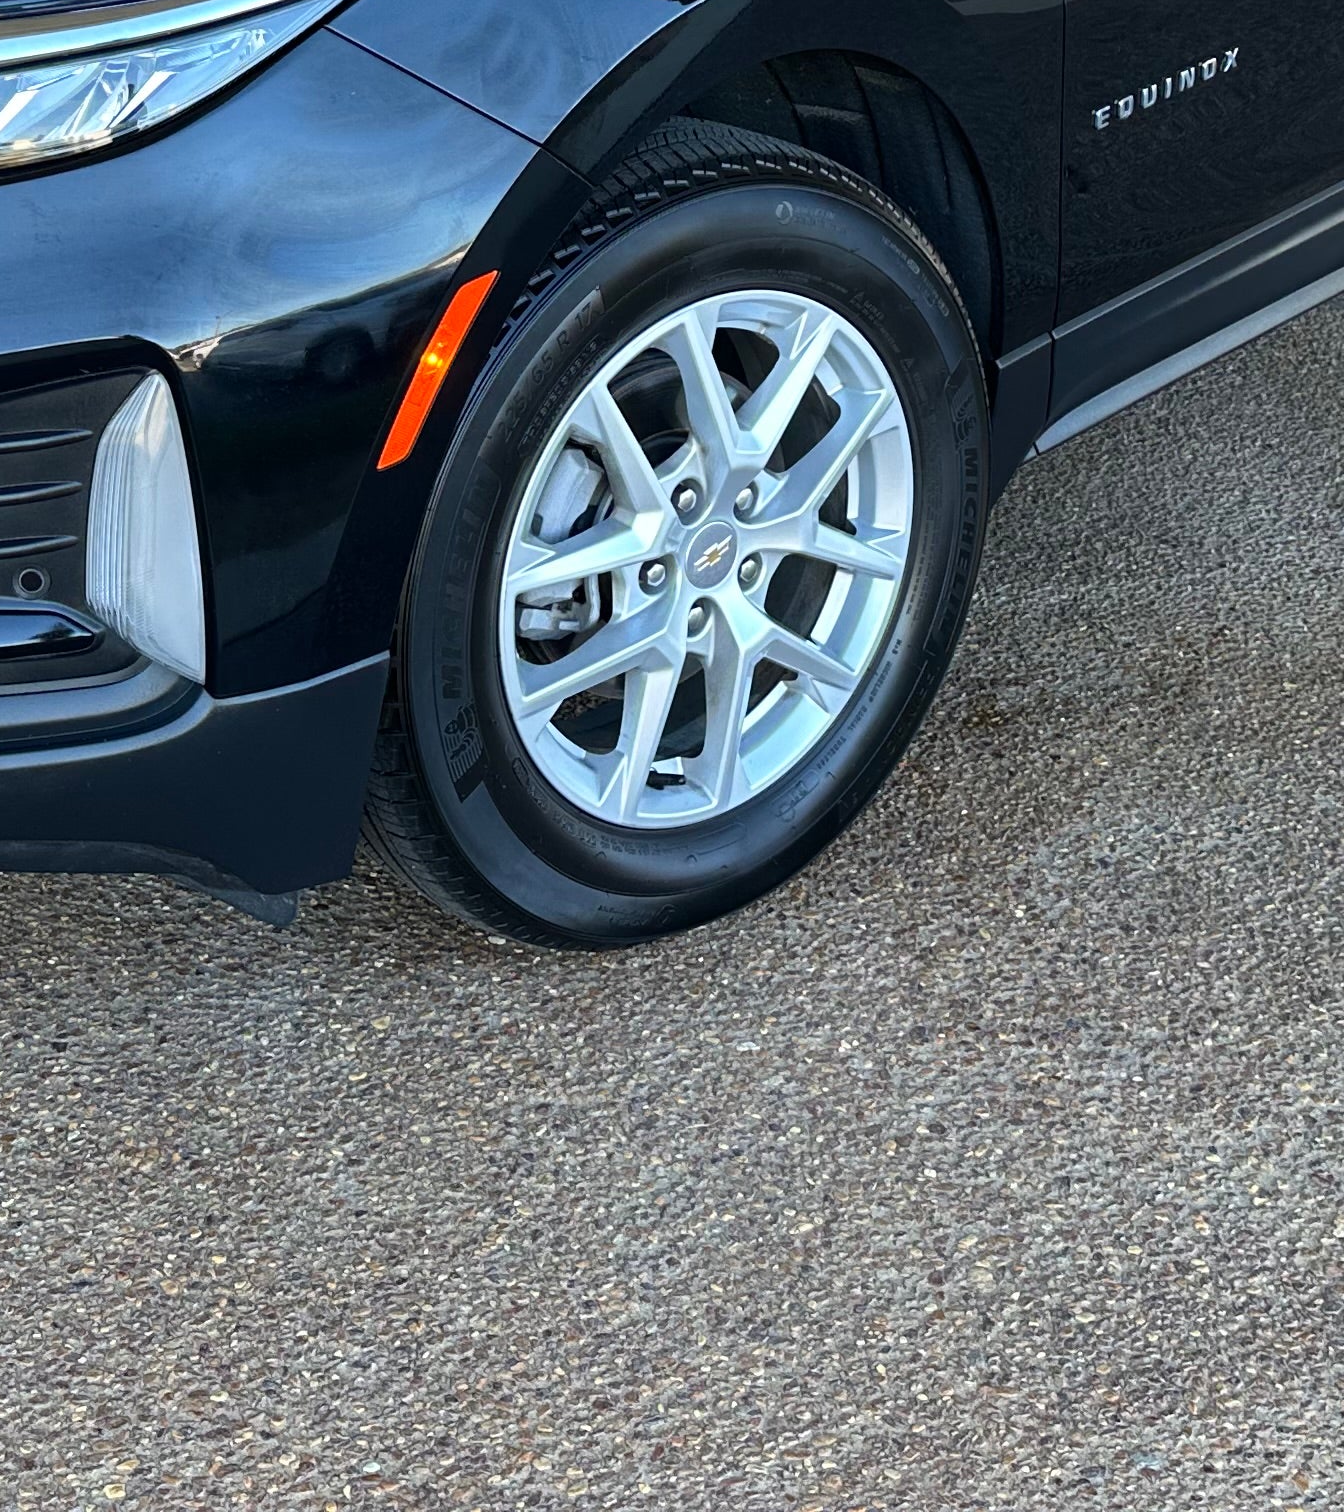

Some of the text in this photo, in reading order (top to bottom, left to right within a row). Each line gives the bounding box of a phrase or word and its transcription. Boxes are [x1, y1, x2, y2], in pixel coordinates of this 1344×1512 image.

[1093, 47, 1240, 130] EQUINOX
[574, 301, 594, 332] 17
[441, 468, 494, 699] MICHELIN
[937, 447, 978, 631] MICHELIN
